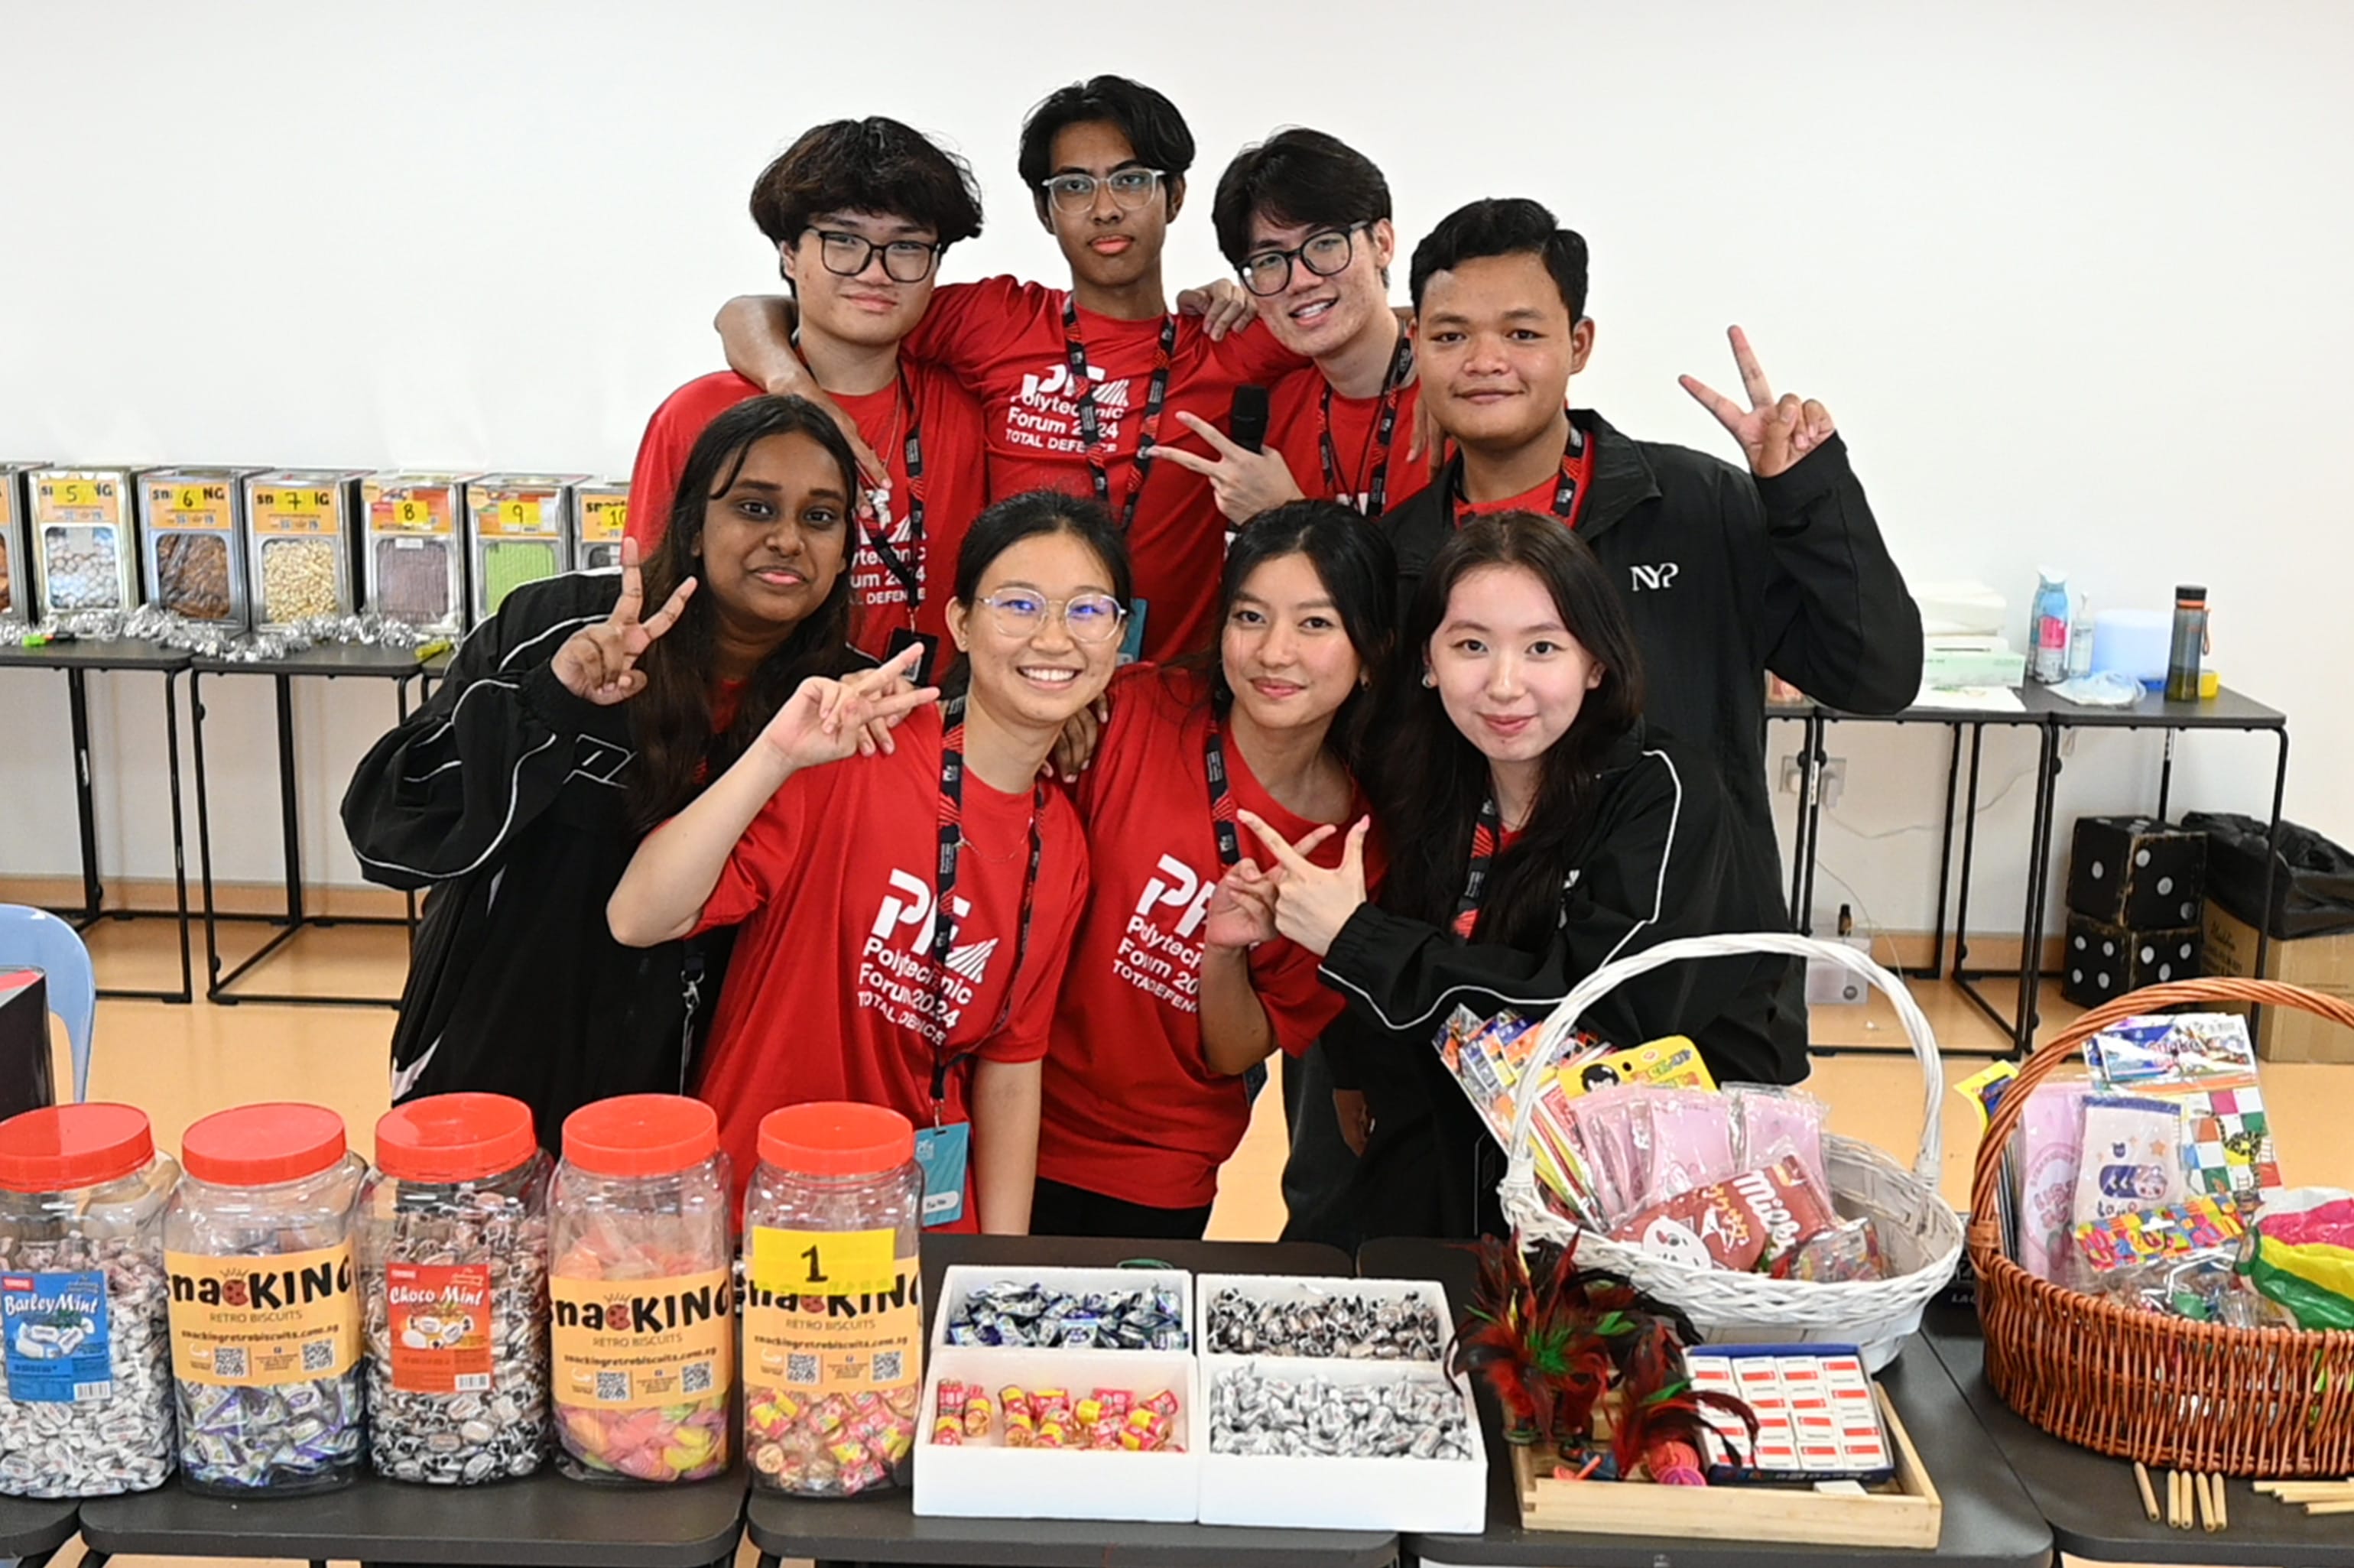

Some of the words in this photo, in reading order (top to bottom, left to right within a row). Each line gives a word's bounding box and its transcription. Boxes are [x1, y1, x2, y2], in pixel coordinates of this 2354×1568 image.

[1010, 393, 1125, 420] olytecnic
[1007, 406, 1067, 434] Forum
[1071, 419, 1119, 439] 224
[1005, 428, 1044, 448] TOTAL
[67, 485, 78, 502] 5
[183, 490, 193, 508] 6
[285, 492, 301, 510] 7
[404, 503, 415, 521] 8
[512, 505, 523, 523] 9
[1629, 562, 1679, 592] NYP
[800, 1245, 828, 1282] 1
[4, 1294, 54, 1316] Barley
[54, 1293, 98, 1313] Mint
[389, 1286, 435, 1304] Choco
[440, 1286, 483, 1306] Mint
[209, 1313, 246, 1323] RETRO
[250, 1310, 303, 1323] BISCUITS
[786, 1320, 822, 1330] RETRO
[825, 1318, 875, 1330] BISCUITS
[593, 1338, 628, 1348] RETRO
[632, 1333, 683, 1346] BISCUITS
